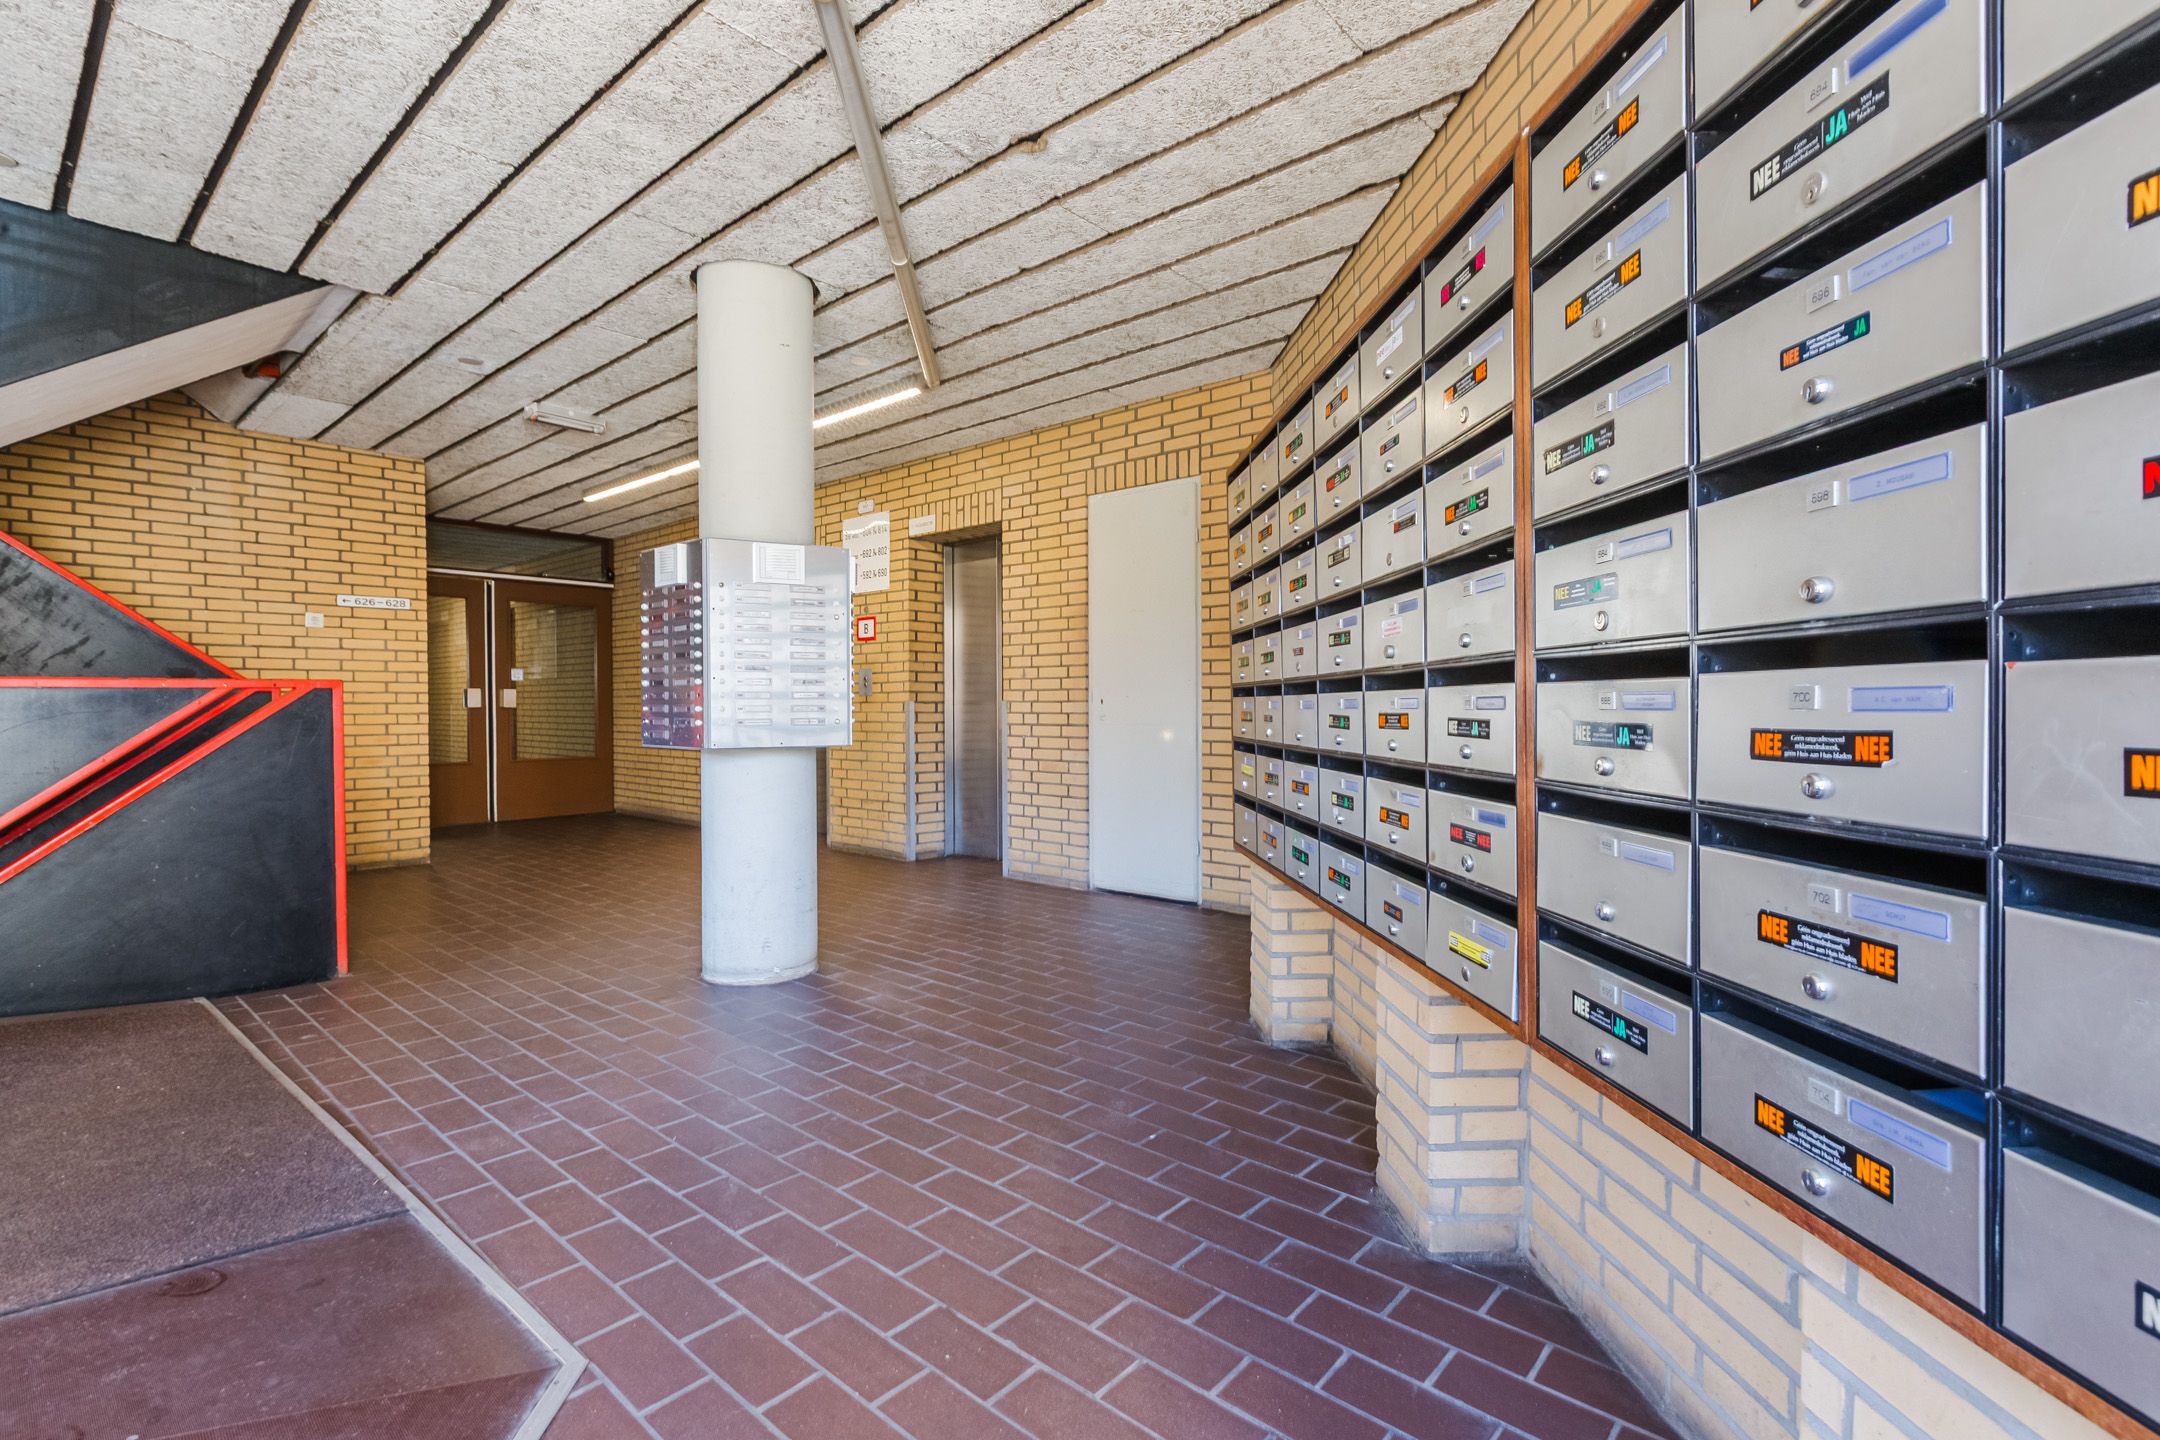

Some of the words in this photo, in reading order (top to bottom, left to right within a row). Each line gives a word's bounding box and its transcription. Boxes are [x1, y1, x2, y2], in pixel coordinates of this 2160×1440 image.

[1618, 100, 1638, 137] NEE
[1826, 108, 1848, 145] JA
[1565, 156, 1580, 188] NEE
[1753, 155, 1780, 197] NEE
[1621, 253, 1640, 285] NEE
[1566, 298, 1582, 326] NEE
[1854, 317, 1866, 337] JA
[1783, 346, 1800, 368] NEE
[1583, 433, 1595, 456] JA
[1547, 449, 1561, 474] NEE
[1555, 586, 1569, 601] NEE
[864, 623, 869, 634] B
[1575, 725, 1591, 742] NEE
[1616, 727, 1630, 747] JA
[1754, 732, 1783, 758] NEE
[1854, 735, 1891, 763] NEE
[1451, 826, 1464, 841] NEE
[1477, 833, 1492, 850] NEE
[1812, 890, 1831, 905] 702
[1760, 914, 1789, 944] NEE
[1861, 941, 1896, 977] NEE
[1574, 995, 1590, 1020] NEE
[1614, 1017, 1627, 1040] JA
[1757, 1100, 1785, 1136] NEE
[1856, 1153, 1891, 1197] NEE
